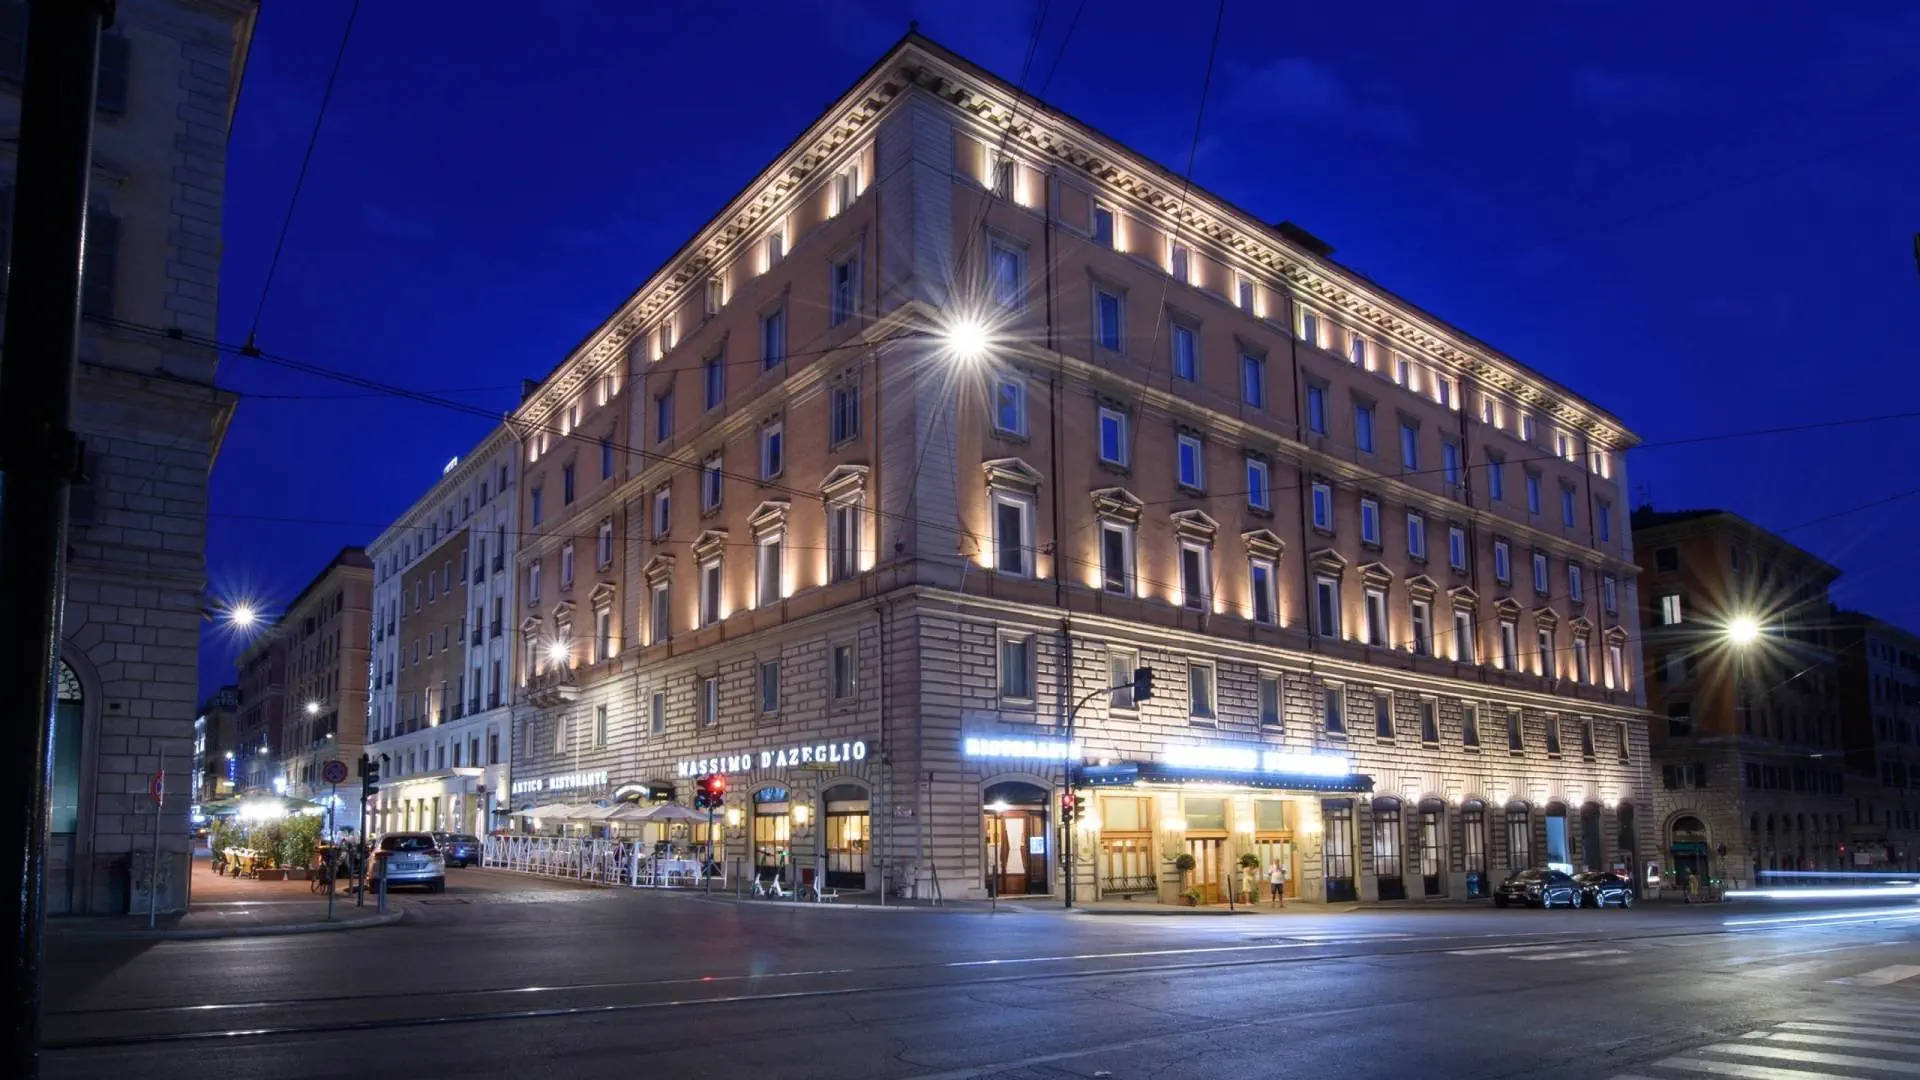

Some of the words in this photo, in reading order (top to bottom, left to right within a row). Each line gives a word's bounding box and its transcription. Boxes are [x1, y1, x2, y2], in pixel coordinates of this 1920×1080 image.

[678, 754, 752, 777] MASSIMO
[761, 741, 866, 768] D'AZEGLIO
[512, 779, 543, 794] ANTICO
[549, 771, 608, 790] RISTORANTE
